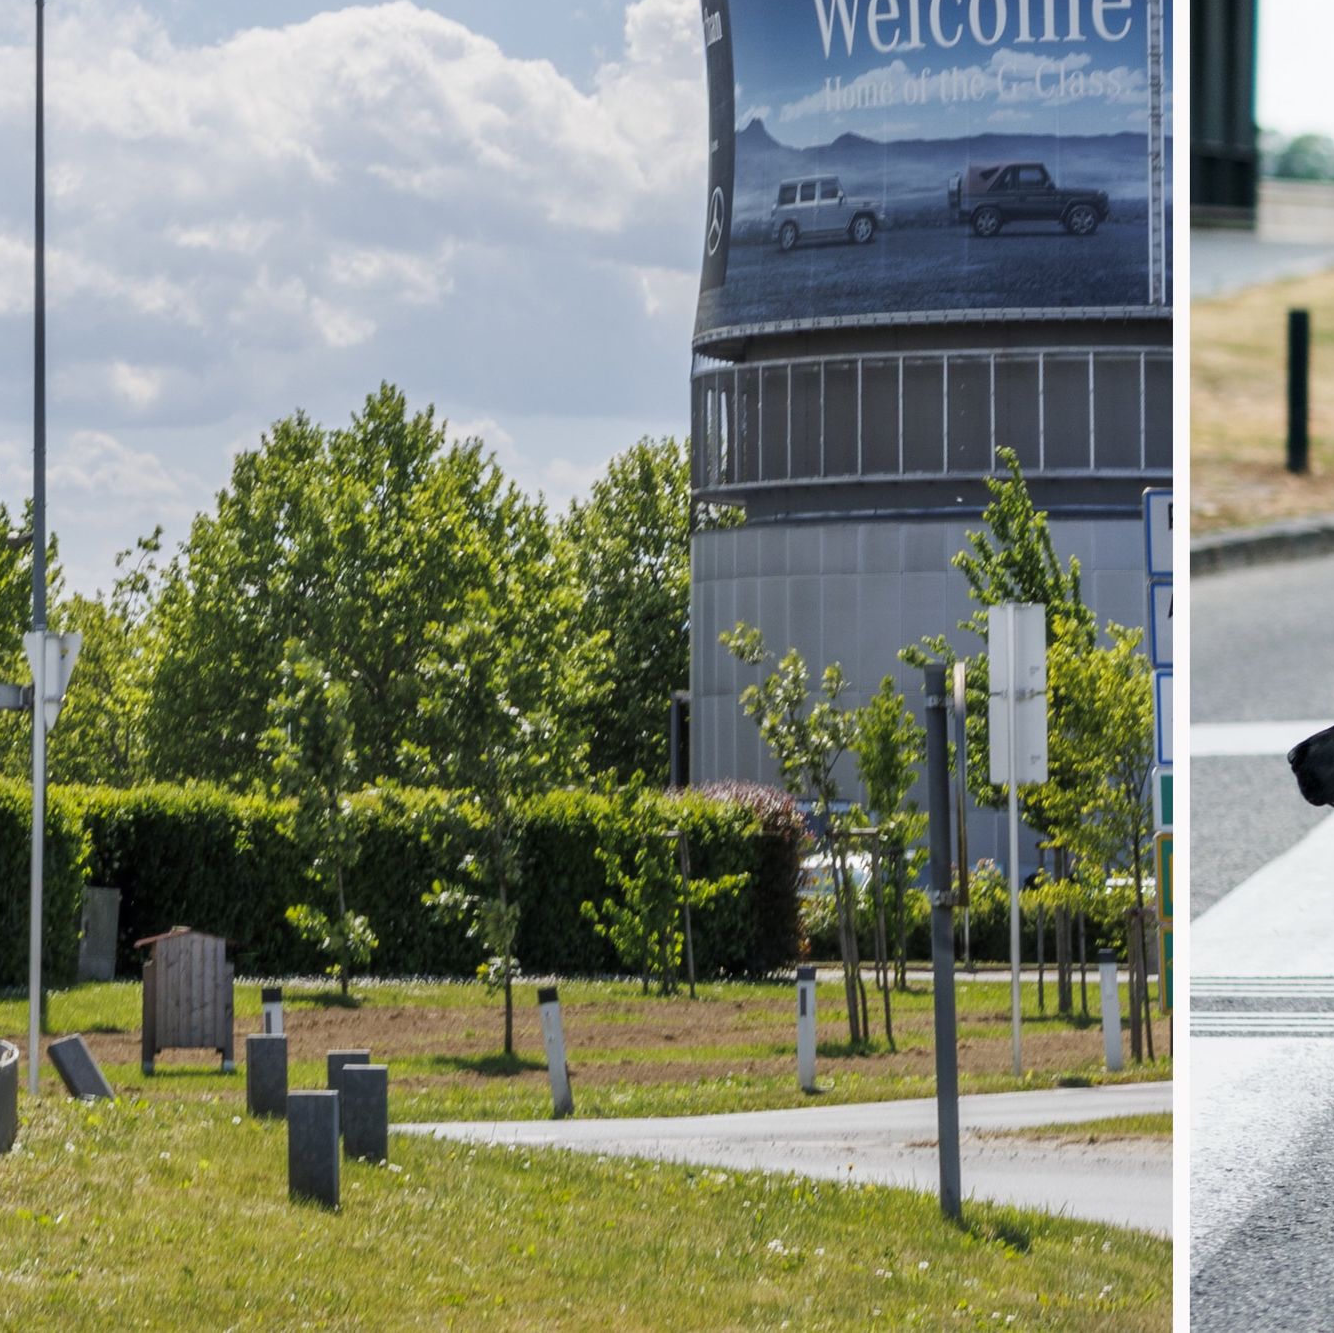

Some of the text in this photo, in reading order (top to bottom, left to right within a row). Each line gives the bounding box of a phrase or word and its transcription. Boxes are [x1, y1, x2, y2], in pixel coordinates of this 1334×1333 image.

[823, 76, 894, 113] Home
[904, 66, 931, 105] of
[939, 66, 986, 103] the
